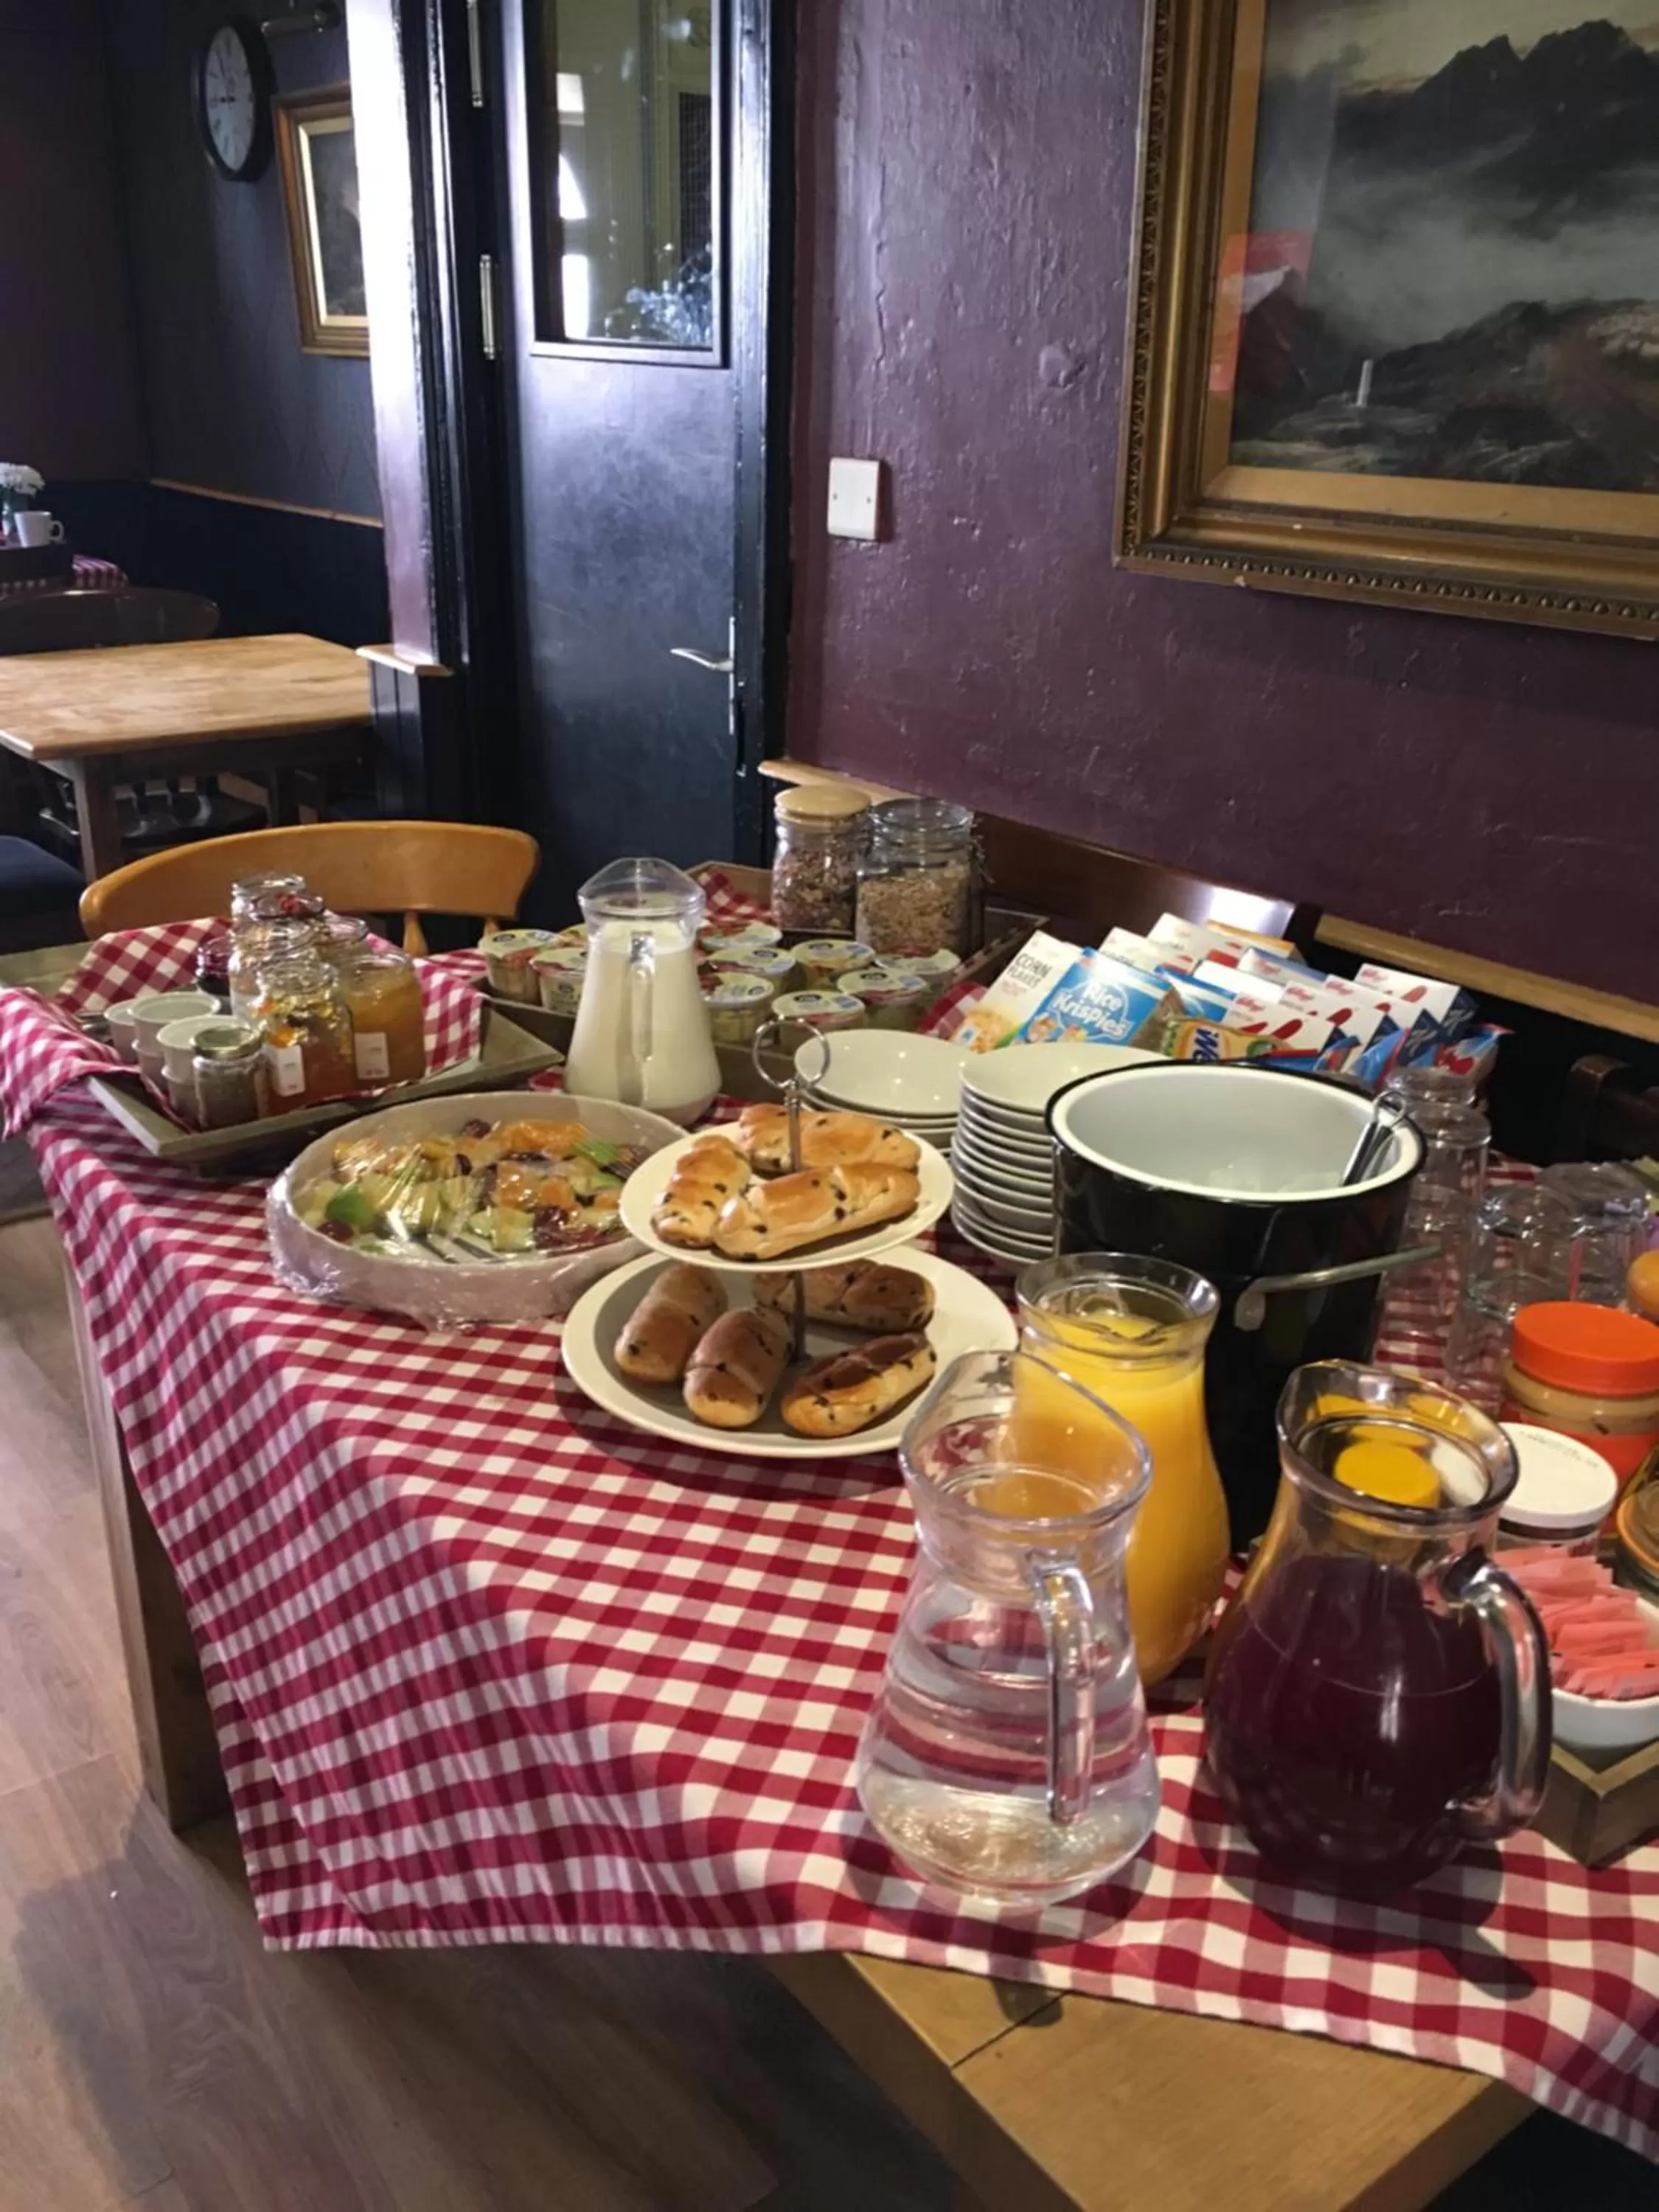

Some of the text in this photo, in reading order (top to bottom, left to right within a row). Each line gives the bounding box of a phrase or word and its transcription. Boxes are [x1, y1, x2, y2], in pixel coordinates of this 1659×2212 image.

[1015, 953, 1053, 978] CORN
[1082, 979, 1124, 1011] Rice
[1052, 992, 1132, 1037] Krispies
